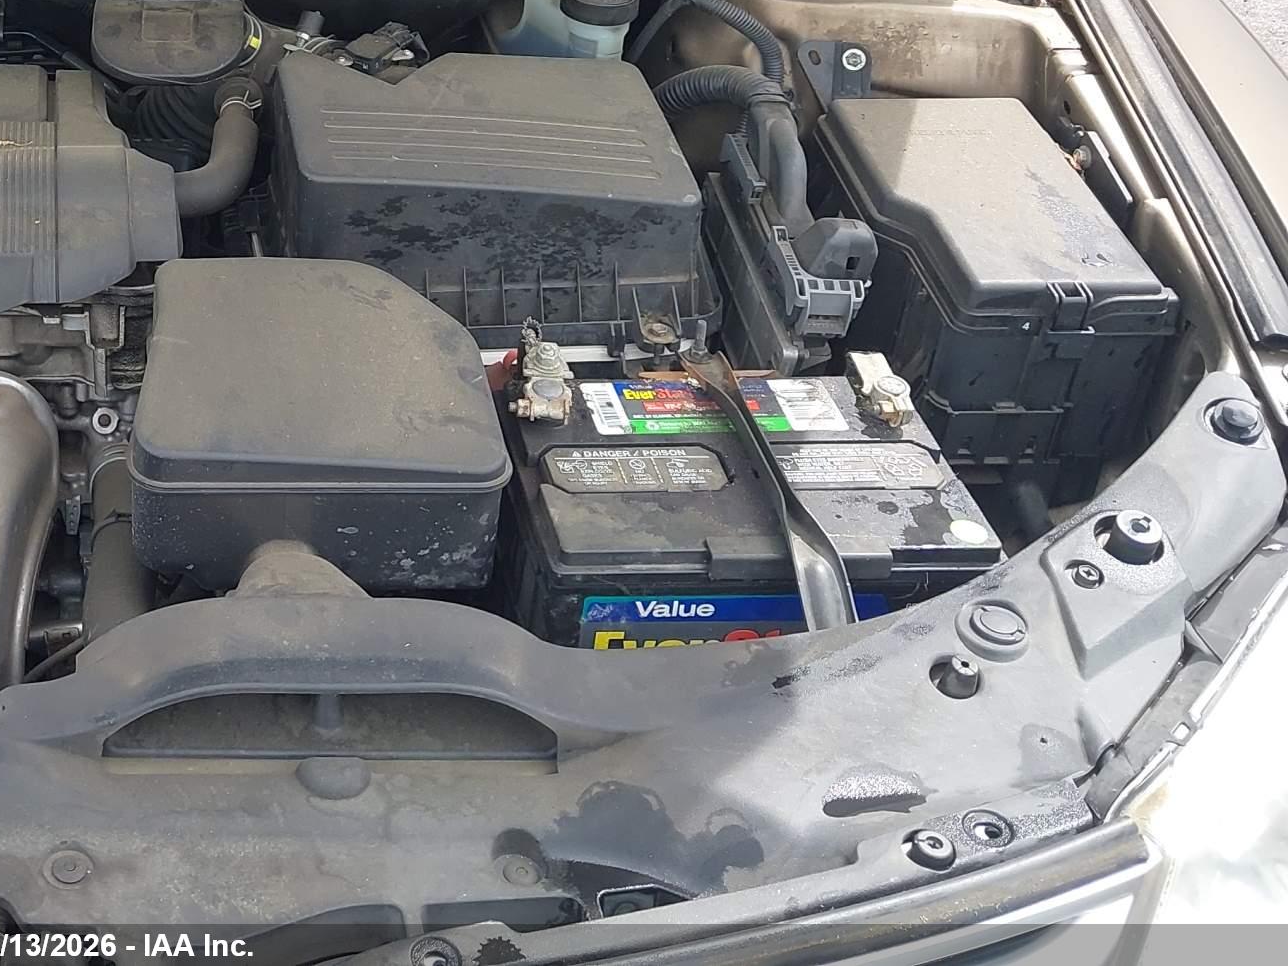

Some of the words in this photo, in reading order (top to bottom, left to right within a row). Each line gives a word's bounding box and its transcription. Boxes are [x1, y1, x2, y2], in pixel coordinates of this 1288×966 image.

[1021, 321, 1030, 331] 4
[583, 450, 631, 458] DANGER
[643, 449, 686, 457] POISON
[634, 600, 716, 618] Value
